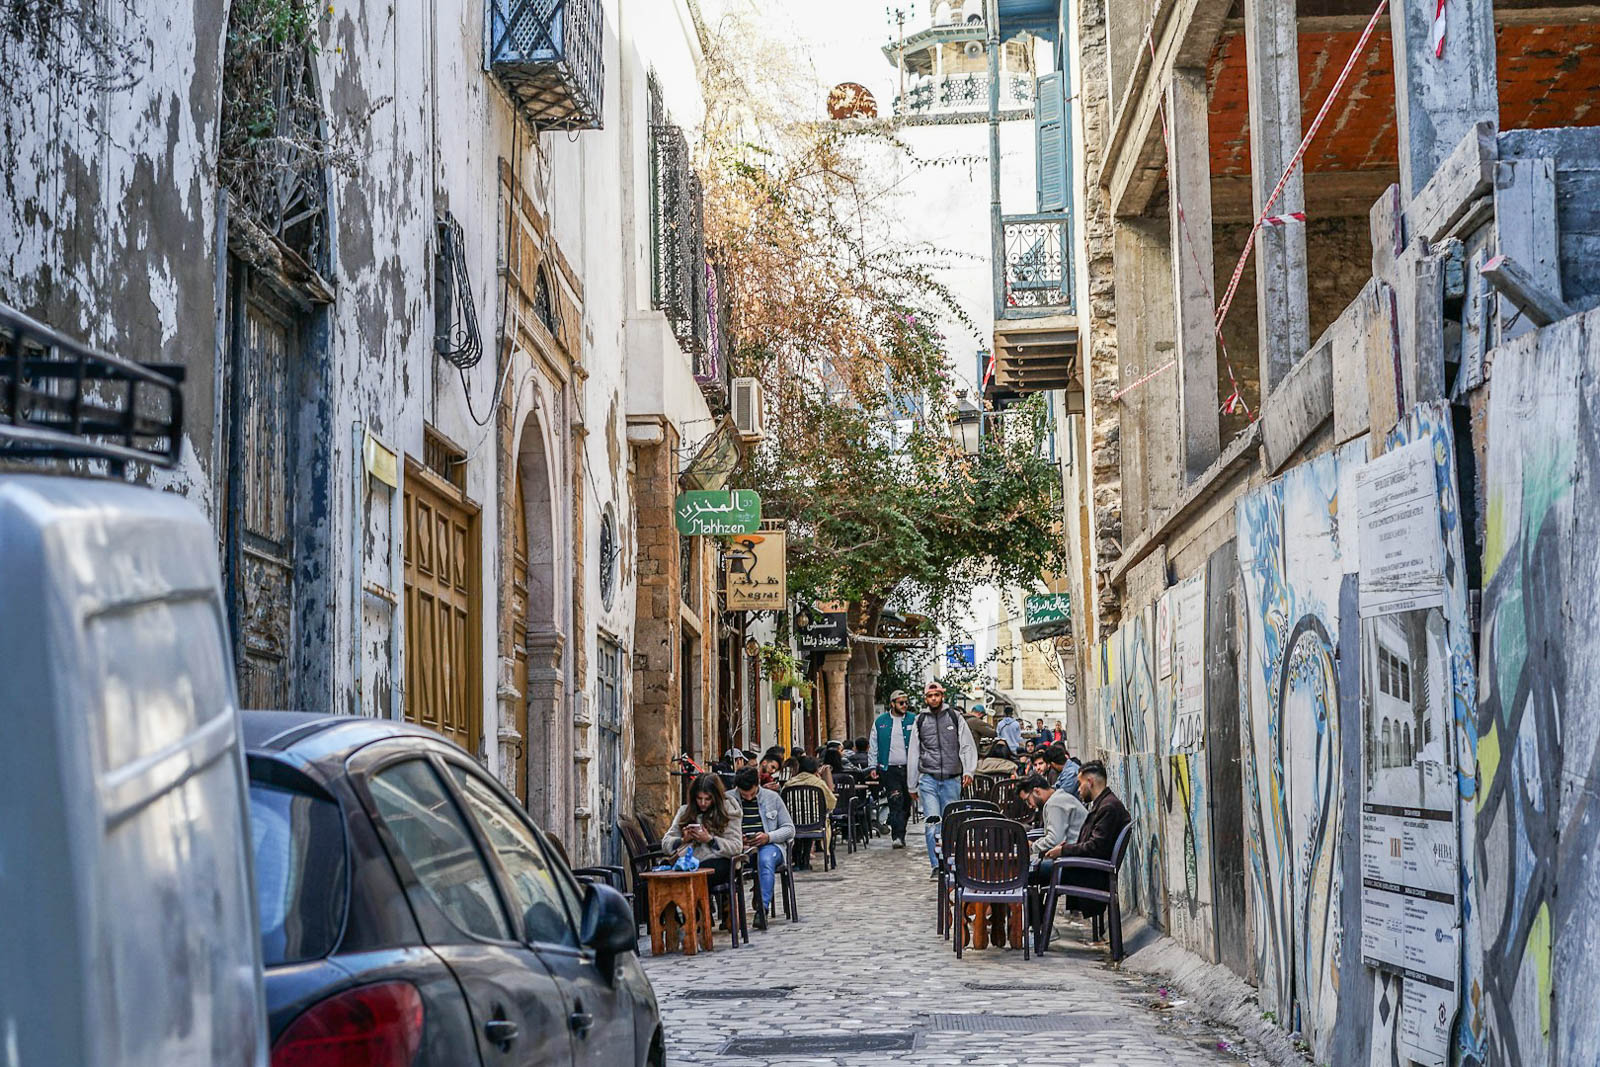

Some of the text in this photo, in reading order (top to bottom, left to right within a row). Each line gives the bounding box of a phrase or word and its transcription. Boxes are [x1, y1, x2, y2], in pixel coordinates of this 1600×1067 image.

[1125, 362, 1139, 376] 60
[678, 491, 744, 523] المخزن
[689, 519, 745, 533] Makhzen
